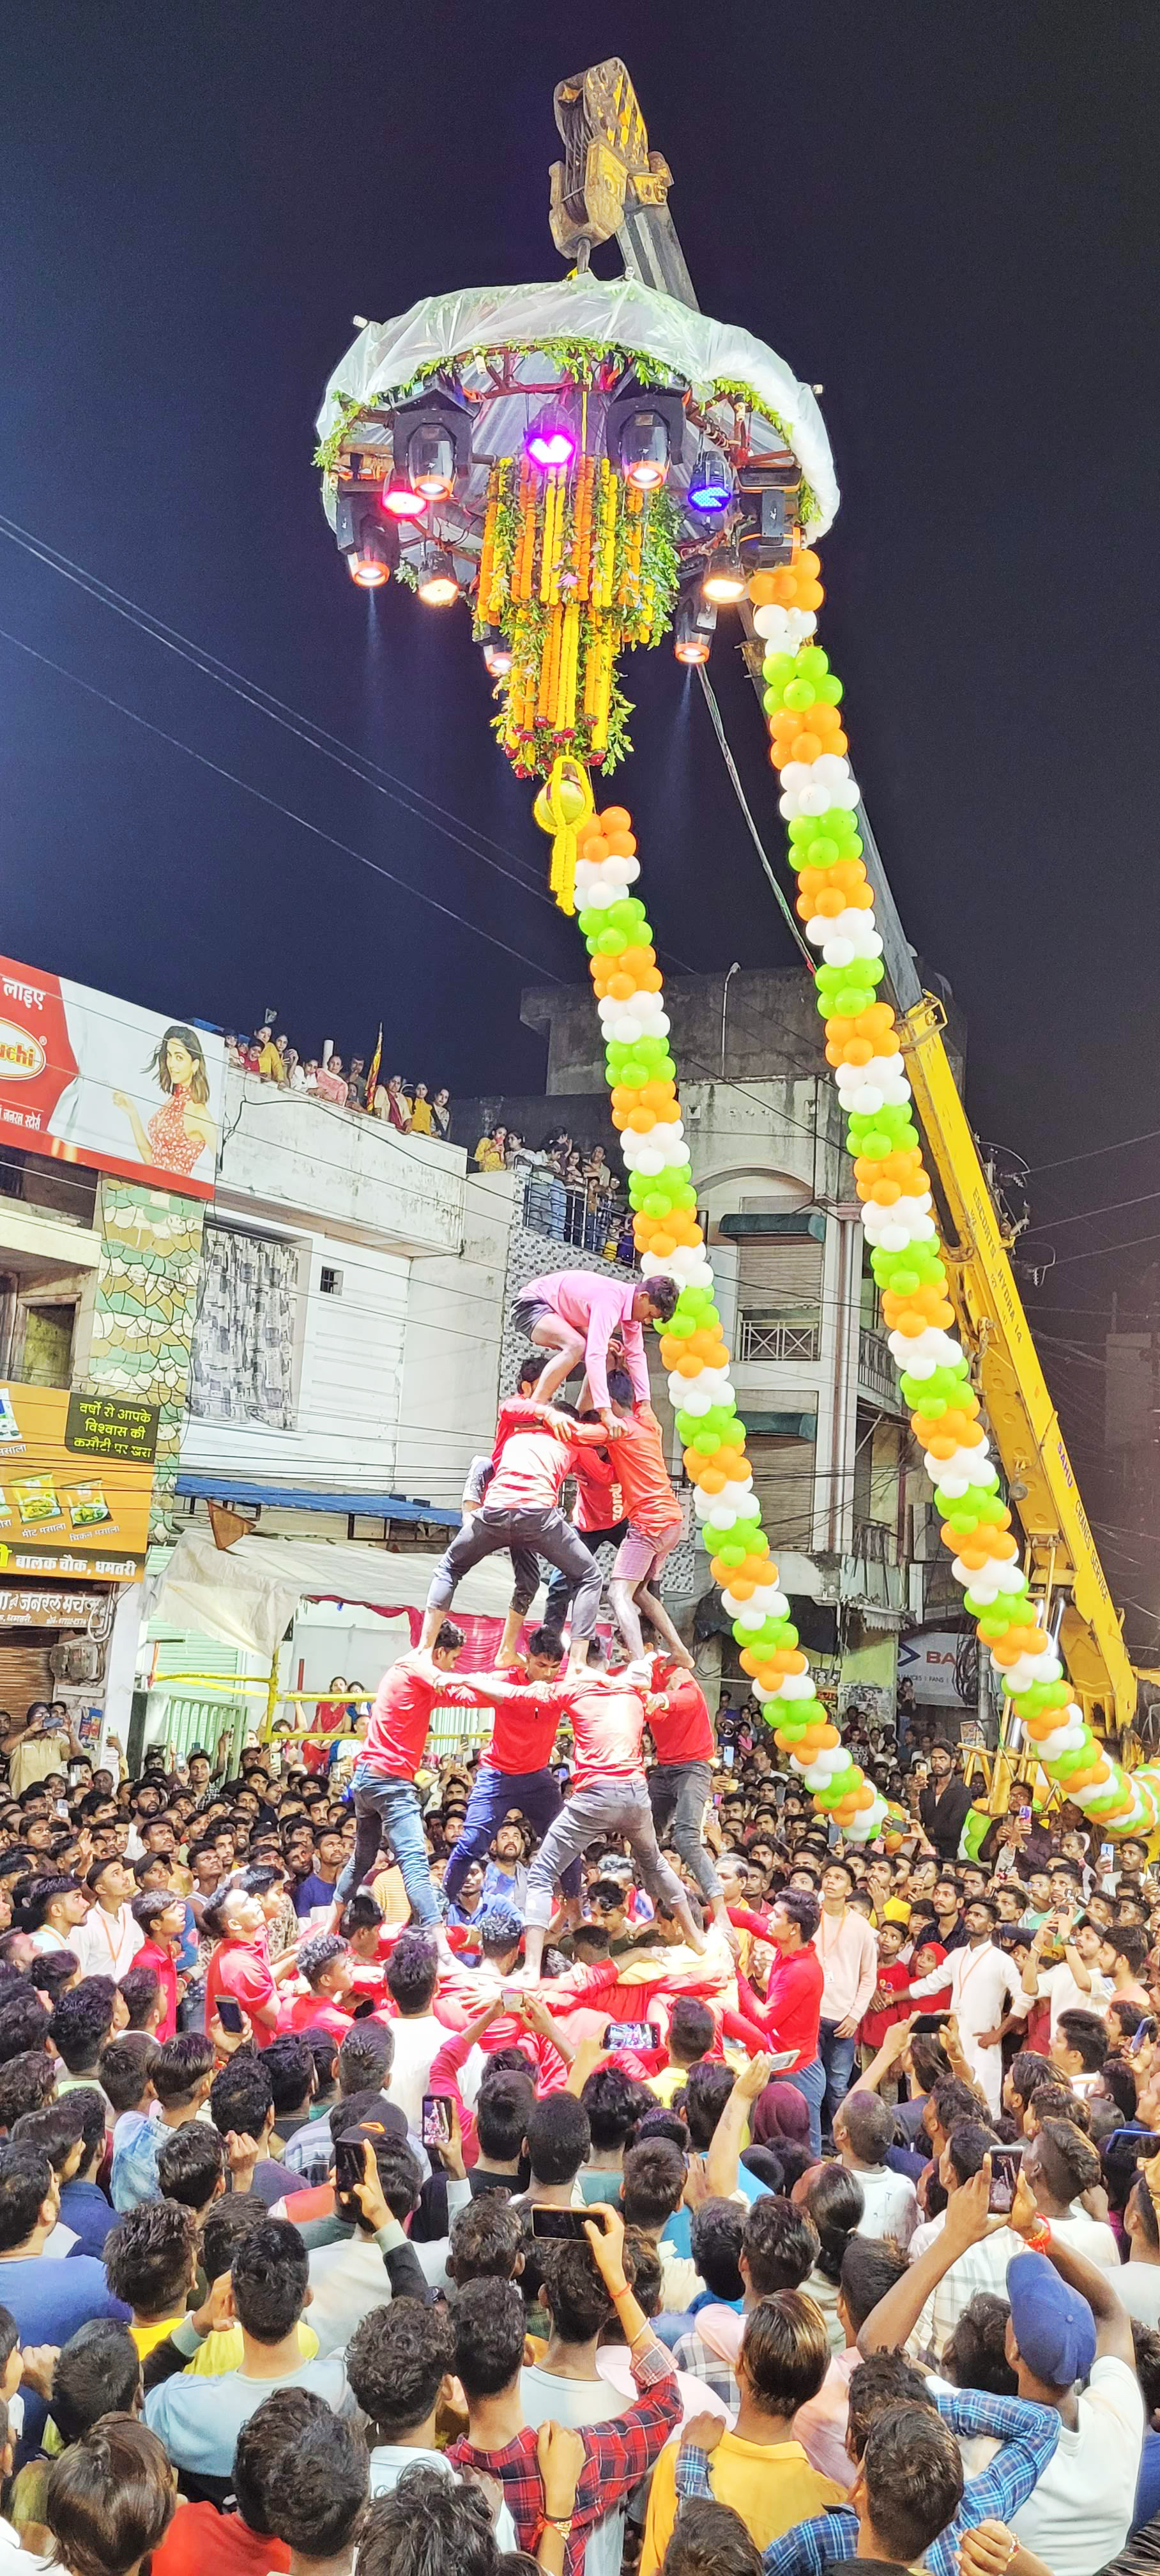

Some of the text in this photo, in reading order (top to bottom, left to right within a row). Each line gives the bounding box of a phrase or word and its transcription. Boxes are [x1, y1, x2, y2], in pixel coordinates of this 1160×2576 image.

[2, 977, 46, 1011] लाइए
[4, 1108, 24, 1126] जनरल
[972, 1186, 996, 1259] ESCORTS
[997, 1269, 1015, 1322] HYDRA
[103, 1402, 116, 1418] से
[117, 1408, 153, 1423] आपके
[84, 1417, 146, 1440] विश्वास की
[73, 1436, 153, 1458] कसौटी पर खरा
[1057, 1441, 1109, 1605] SAHU CRANES SERVICE
[15, 1554, 58, 1571] बालक
[95, 1560, 137, 1576] धमतरी
[19, 1593, 63, 1614] जनरल
